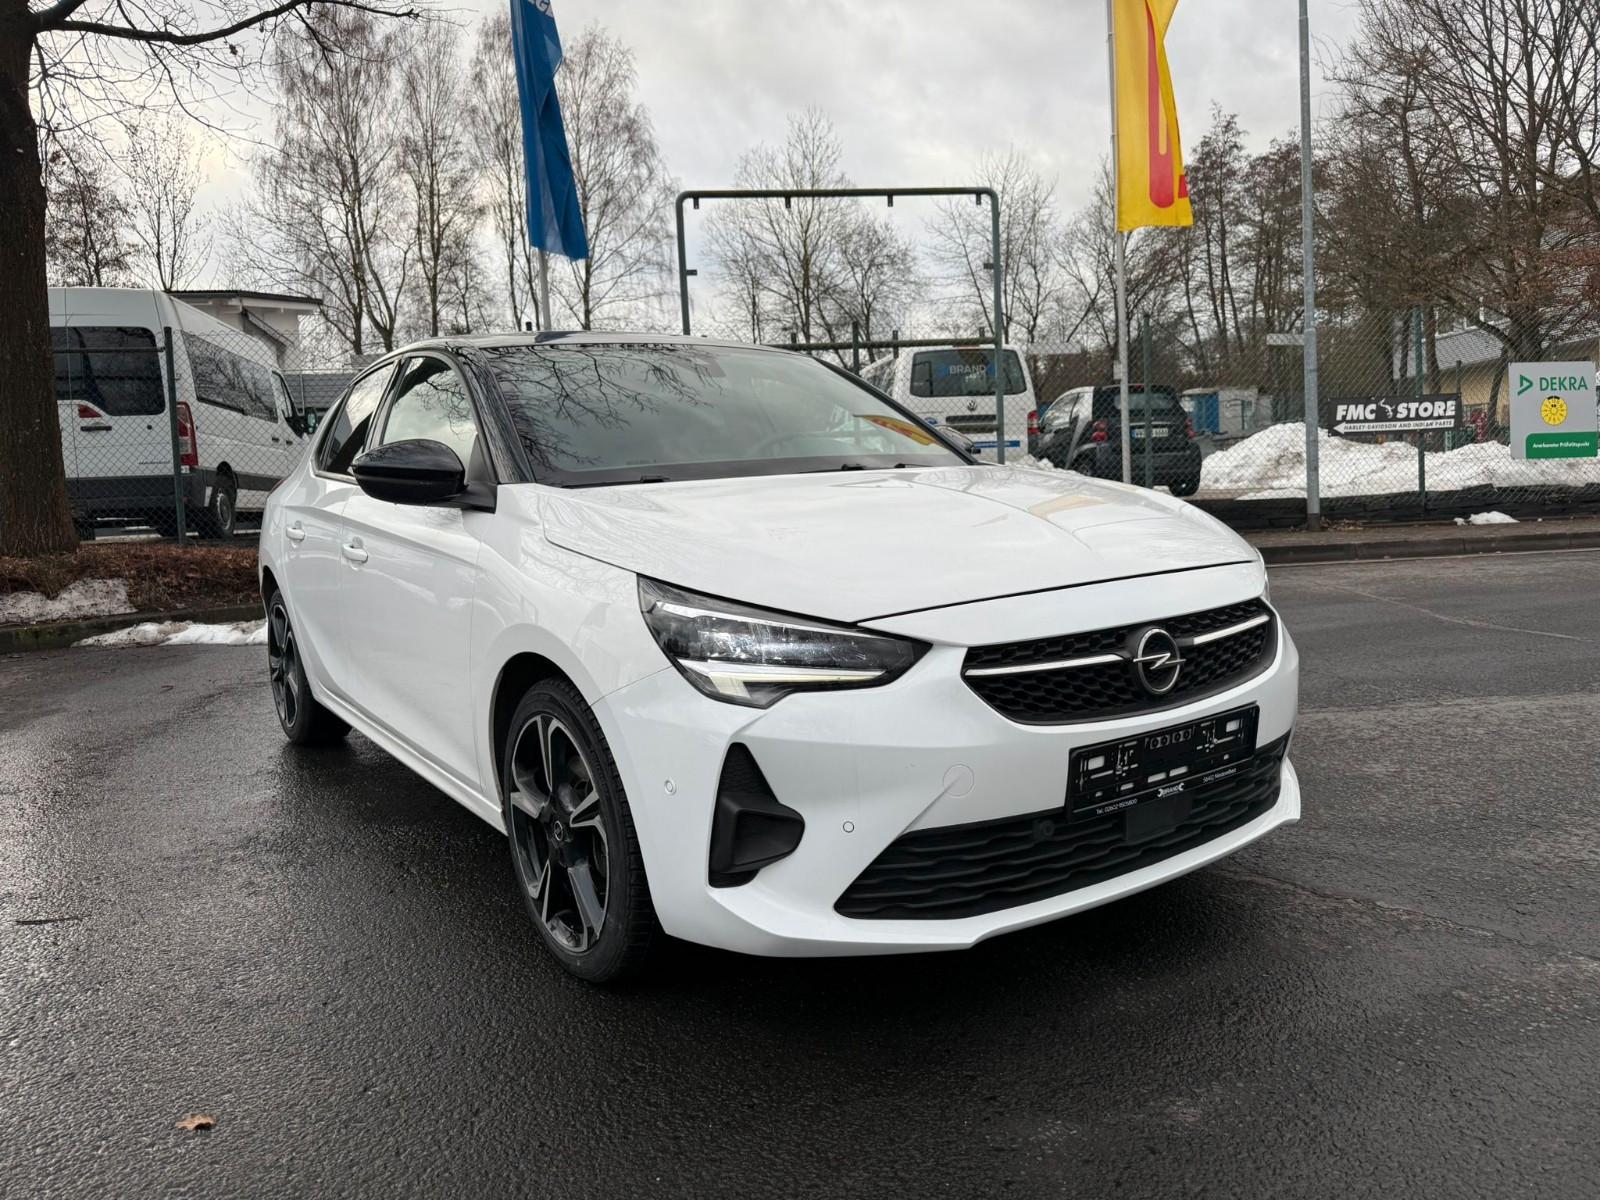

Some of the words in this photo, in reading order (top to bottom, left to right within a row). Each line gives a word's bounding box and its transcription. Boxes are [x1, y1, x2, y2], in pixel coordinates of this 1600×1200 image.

[949, 365, 987, 375] BRAND
[1539, 375, 1588, 392] DEKRA
[1336, 403, 1377, 421] FMC
[1396, 400, 1456, 419] STORE
